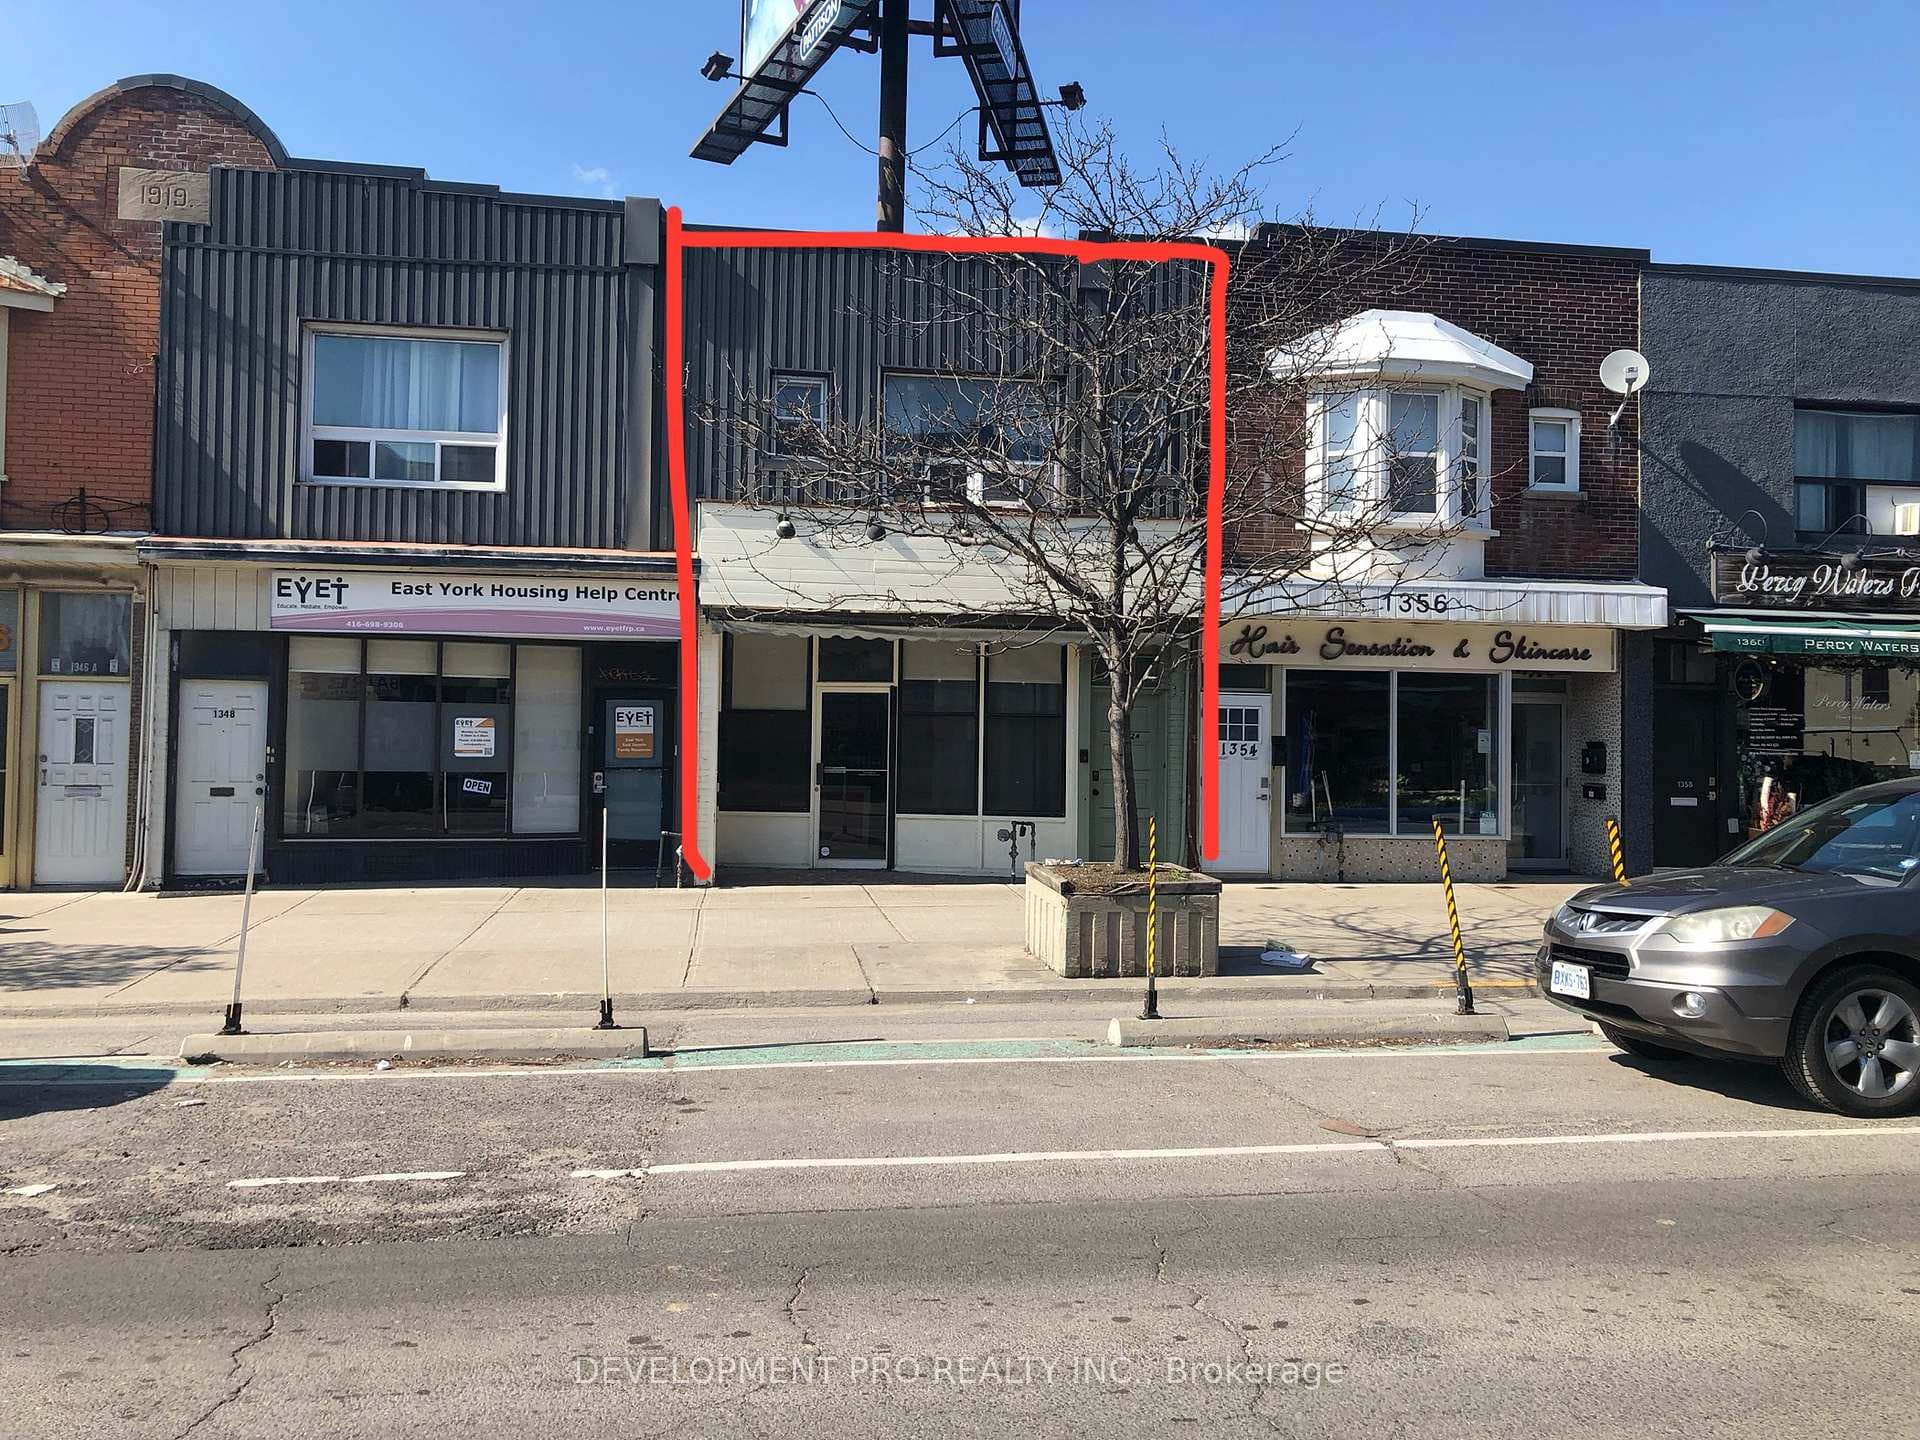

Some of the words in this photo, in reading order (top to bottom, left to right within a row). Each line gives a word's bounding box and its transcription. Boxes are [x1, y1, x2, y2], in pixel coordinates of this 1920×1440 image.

[277, 576, 349, 605] EYET
[391, 581, 433, 596] East
[439, 582, 484, 597] York
[490, 584, 568, 601] Housing
[575, 585, 618, 602] Help
[1736, 563, 1807, 602] Percy
[1813, 564, 1894, 596] Waters
[1382, 592, 1447, 614] 1356
[1230, 624, 1300, 659] Hair
[1319, 626, 1435, 661] Sensation
[1453, 638, 1470, 658] &
[1488, 629, 1593, 664] Skincare
[1804, 638, 1854, 651] PERCY
[1859, 640, 1920, 653] WATERS
[213, 709, 235, 719] 1348
[616, 710, 652, 725] EYET
[1221, 742, 1257, 757] 1354
[464, 779, 491, 793] OPEN
